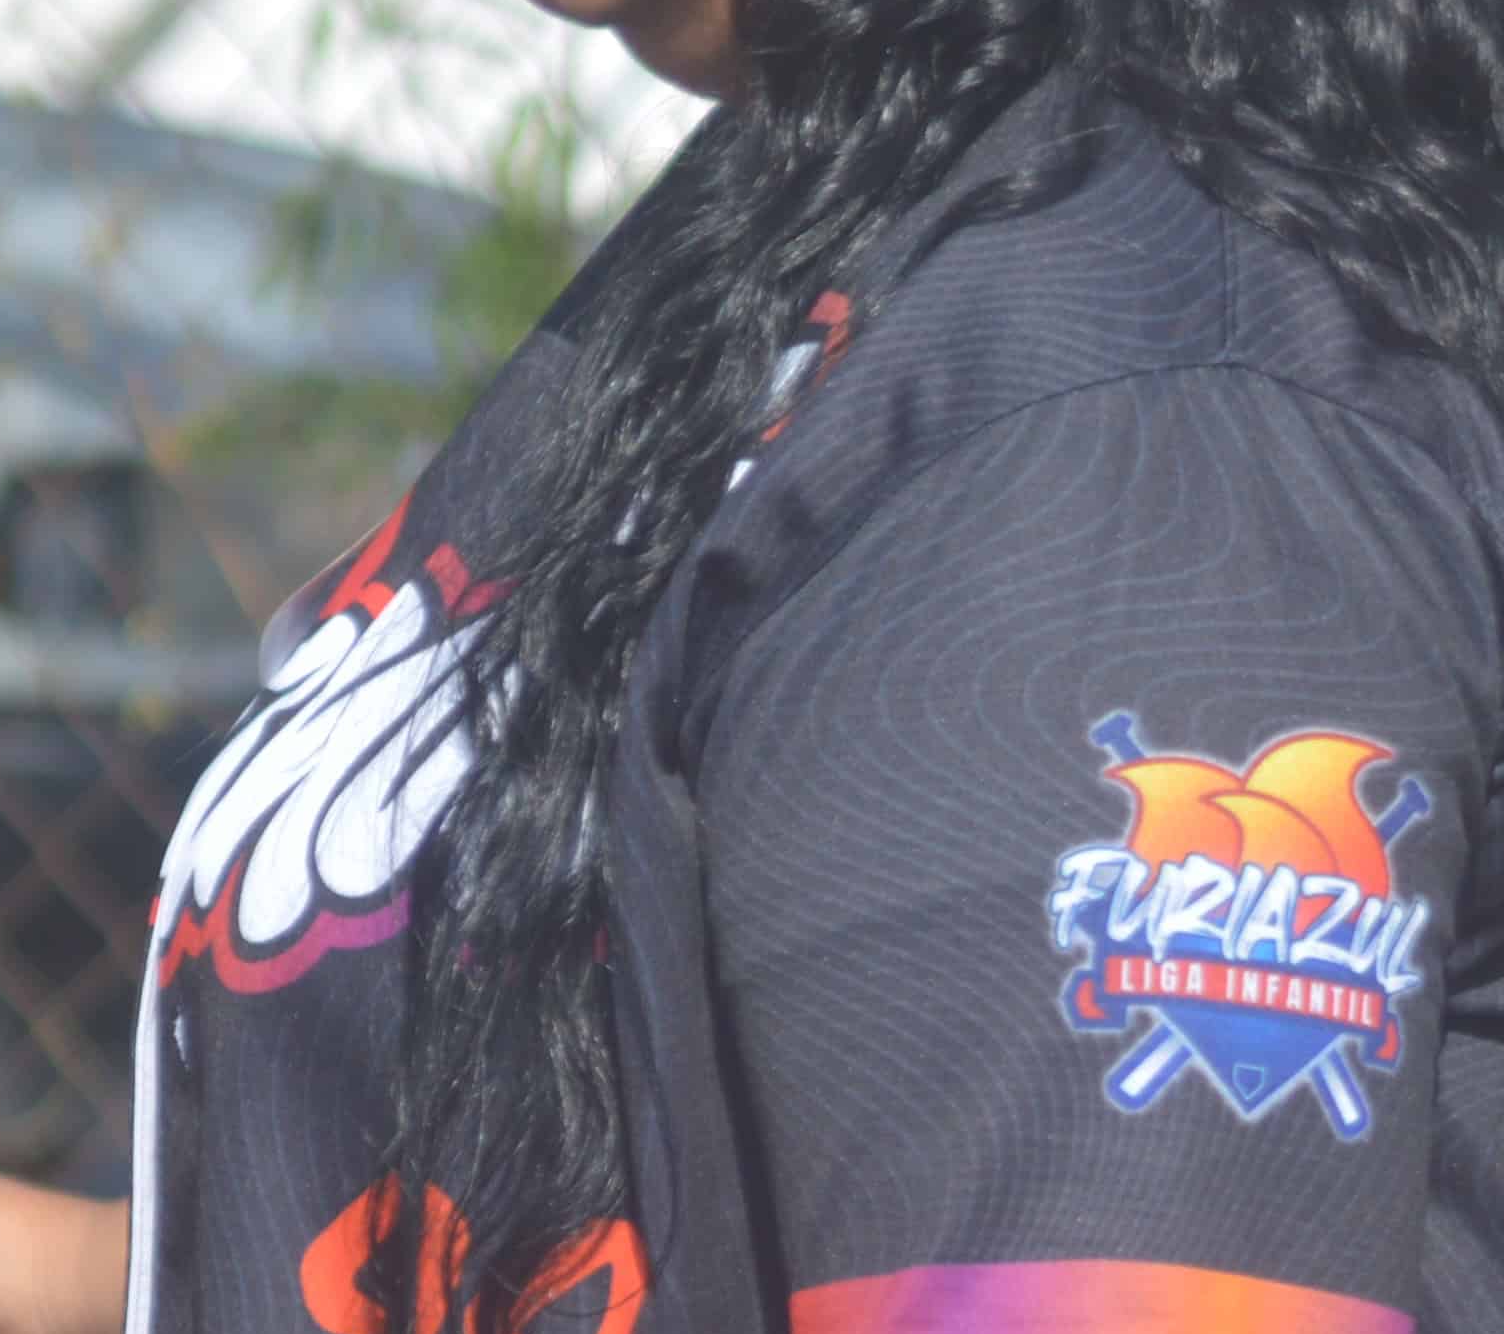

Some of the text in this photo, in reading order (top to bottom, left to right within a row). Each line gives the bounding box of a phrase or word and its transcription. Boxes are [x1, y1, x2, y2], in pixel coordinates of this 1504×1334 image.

[1050, 847, 1430, 995] FURIAZUL
[1120, 959, 1373, 1027] LIGA INFANTIL
